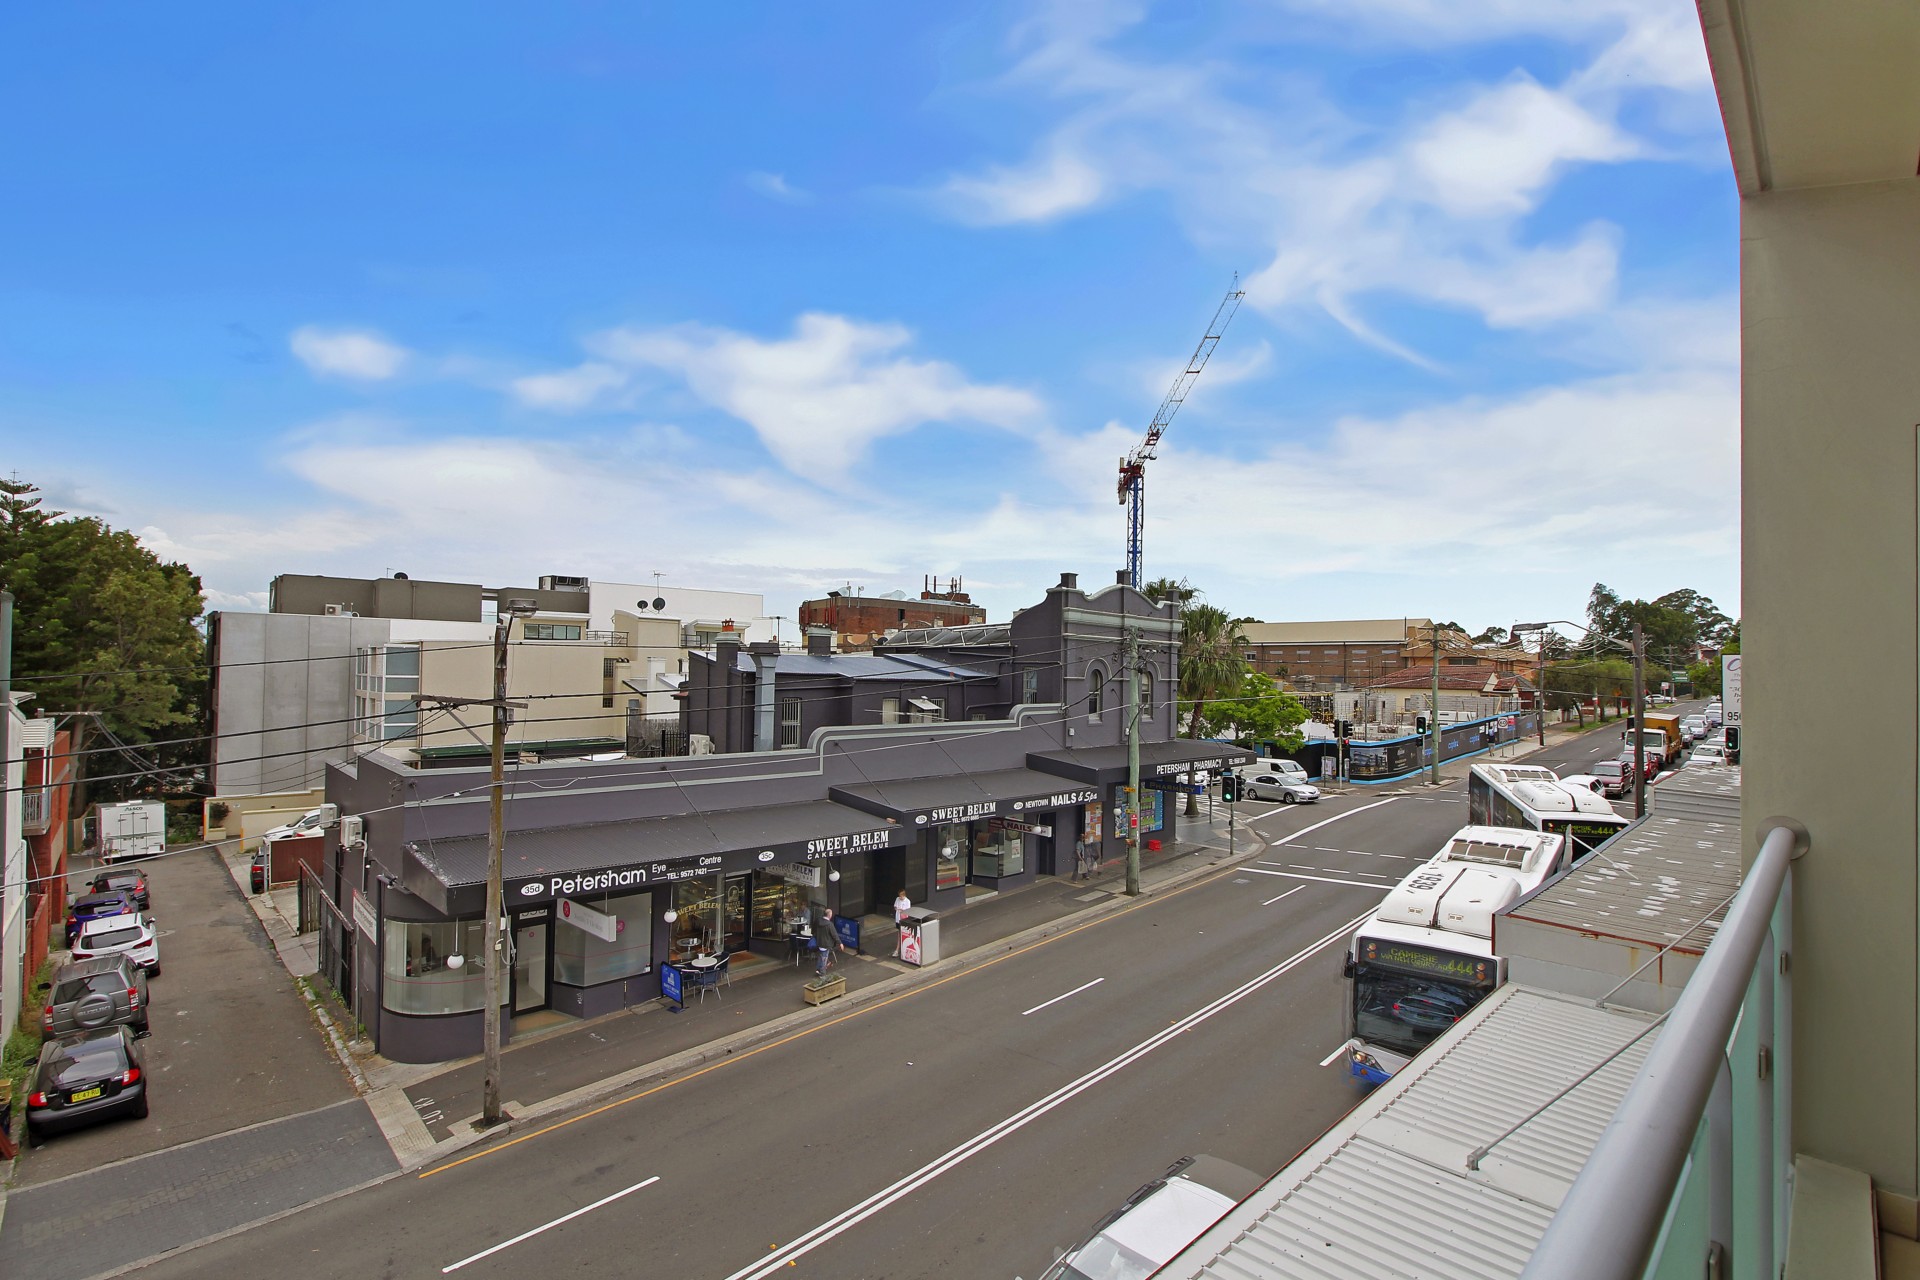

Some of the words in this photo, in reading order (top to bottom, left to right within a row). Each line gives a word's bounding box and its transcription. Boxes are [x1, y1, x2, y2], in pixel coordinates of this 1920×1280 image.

[1728, 712, 1741, 721] 95
[1157, 762, 1190, 775] PETERSHAM
[1194, 758, 1222, 771] PHARMACY
[1150, 782, 1195, 793] PHARMACY
[1025, 799, 1049, 809] NEWTOWN
[1051, 793, 1077, 807] NAILS
[1078, 792, 1084, 802] &
[1084, 791, 1098, 803] Spa
[932, 806, 965, 821] SWEET
[967, 802, 997, 816] BELEM
[1006, 822, 1032, 832] NAILS
[1597, 826, 1615, 835] 444
[808, 836, 848, 853] SWEET
[853, 831, 889, 847] BELEM
[761, 852, 772, 860] 35c
[652, 864, 666, 874] Eye
[700, 855, 722, 866] Centre
[792, 863, 813, 877] BELEM
[667, 872, 680, 880] TEL:
[680, 869, 694, 878] 9572
[694, 867, 707, 876] 7421
[551, 869, 646, 896] Petersham
[1408, 873, 1445, 890] 1939
[525, 884, 540, 895] 35d
[1391, 948, 1438, 963] CAMPSIE
[1448, 959, 1475, 976] 444
